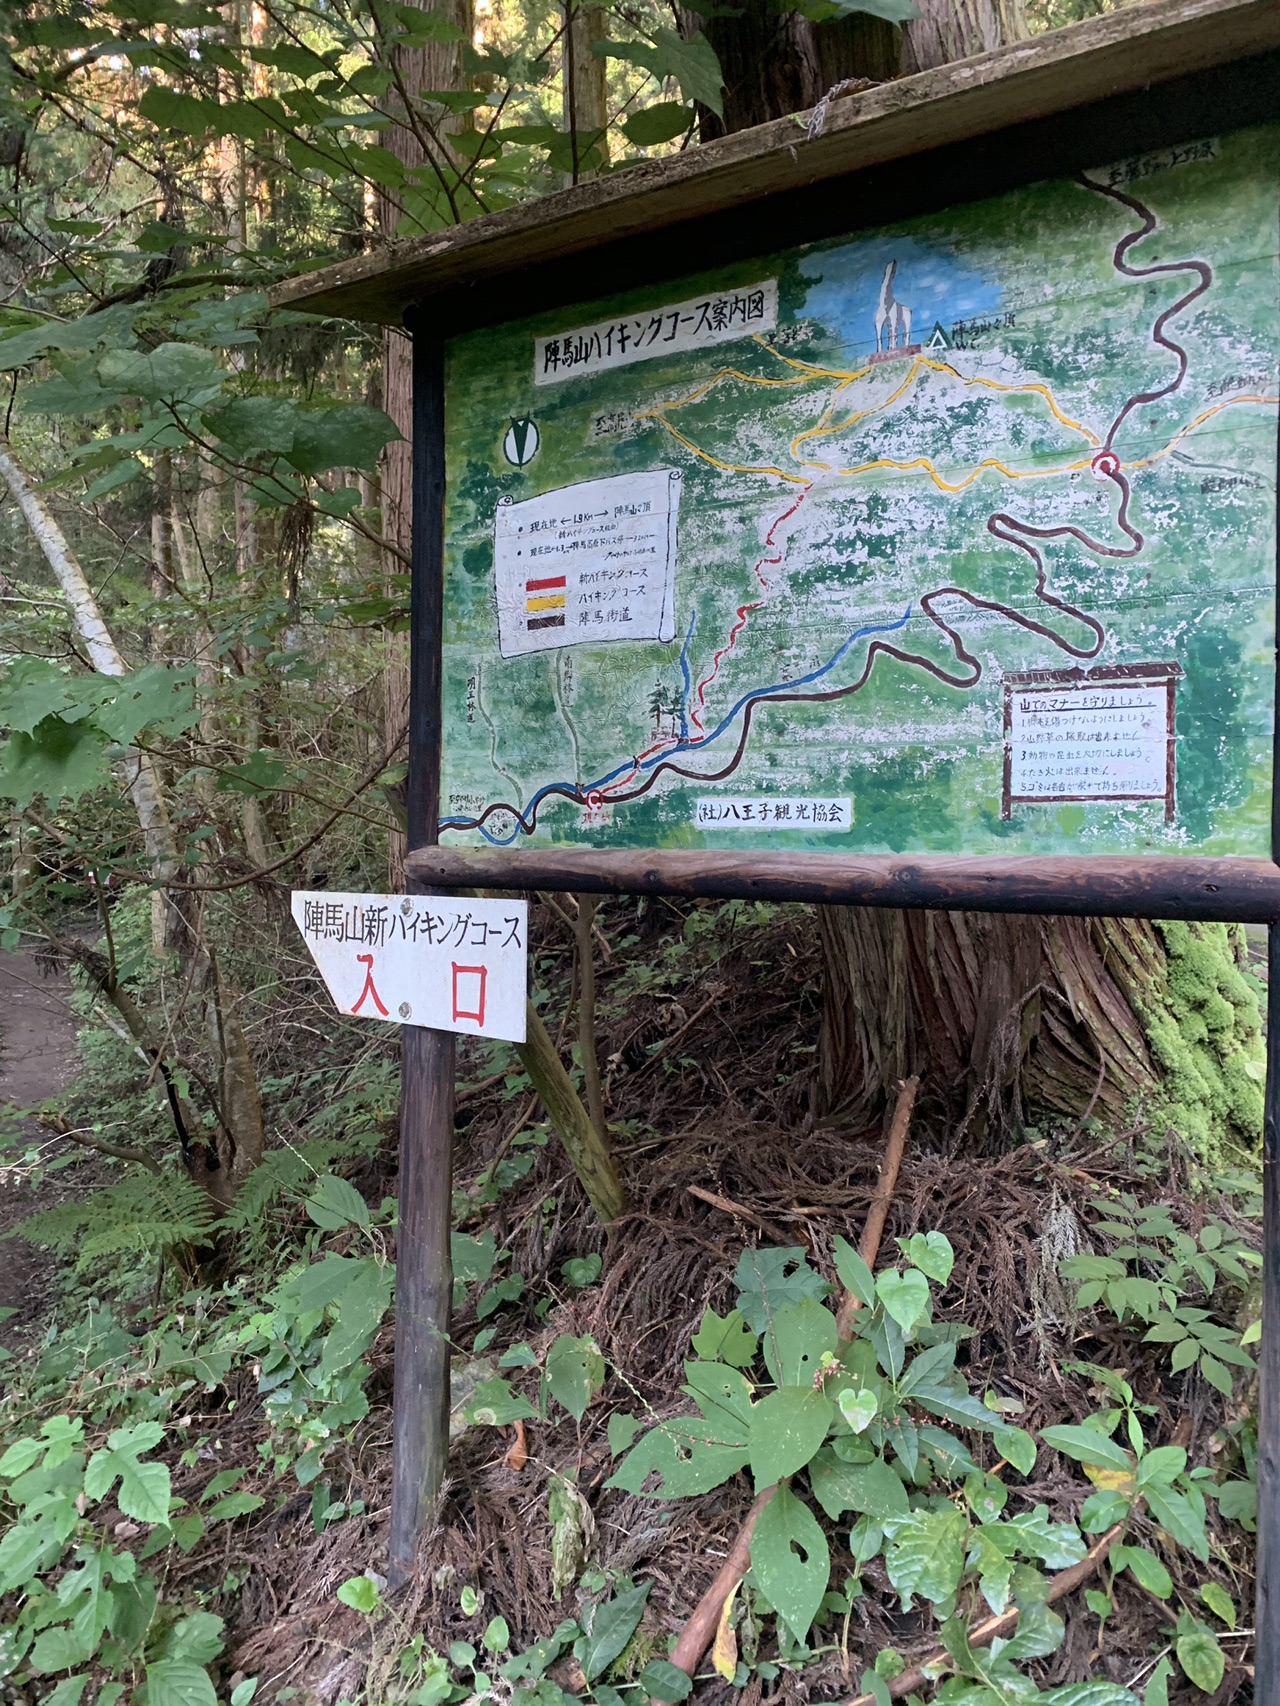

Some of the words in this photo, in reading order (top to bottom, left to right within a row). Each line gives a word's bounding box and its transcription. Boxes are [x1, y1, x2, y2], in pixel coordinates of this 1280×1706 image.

[544, 289, 765, 373] 陣馬山ハイキングコース案内図
[530, 518, 557, 533] 現在地
[578, 606, 633, 627] 陣馬街道
[698, 802, 844, 823] (社)八王子観光協会
[304, 899, 522, 949] 陣馬山新ハイキングコース
